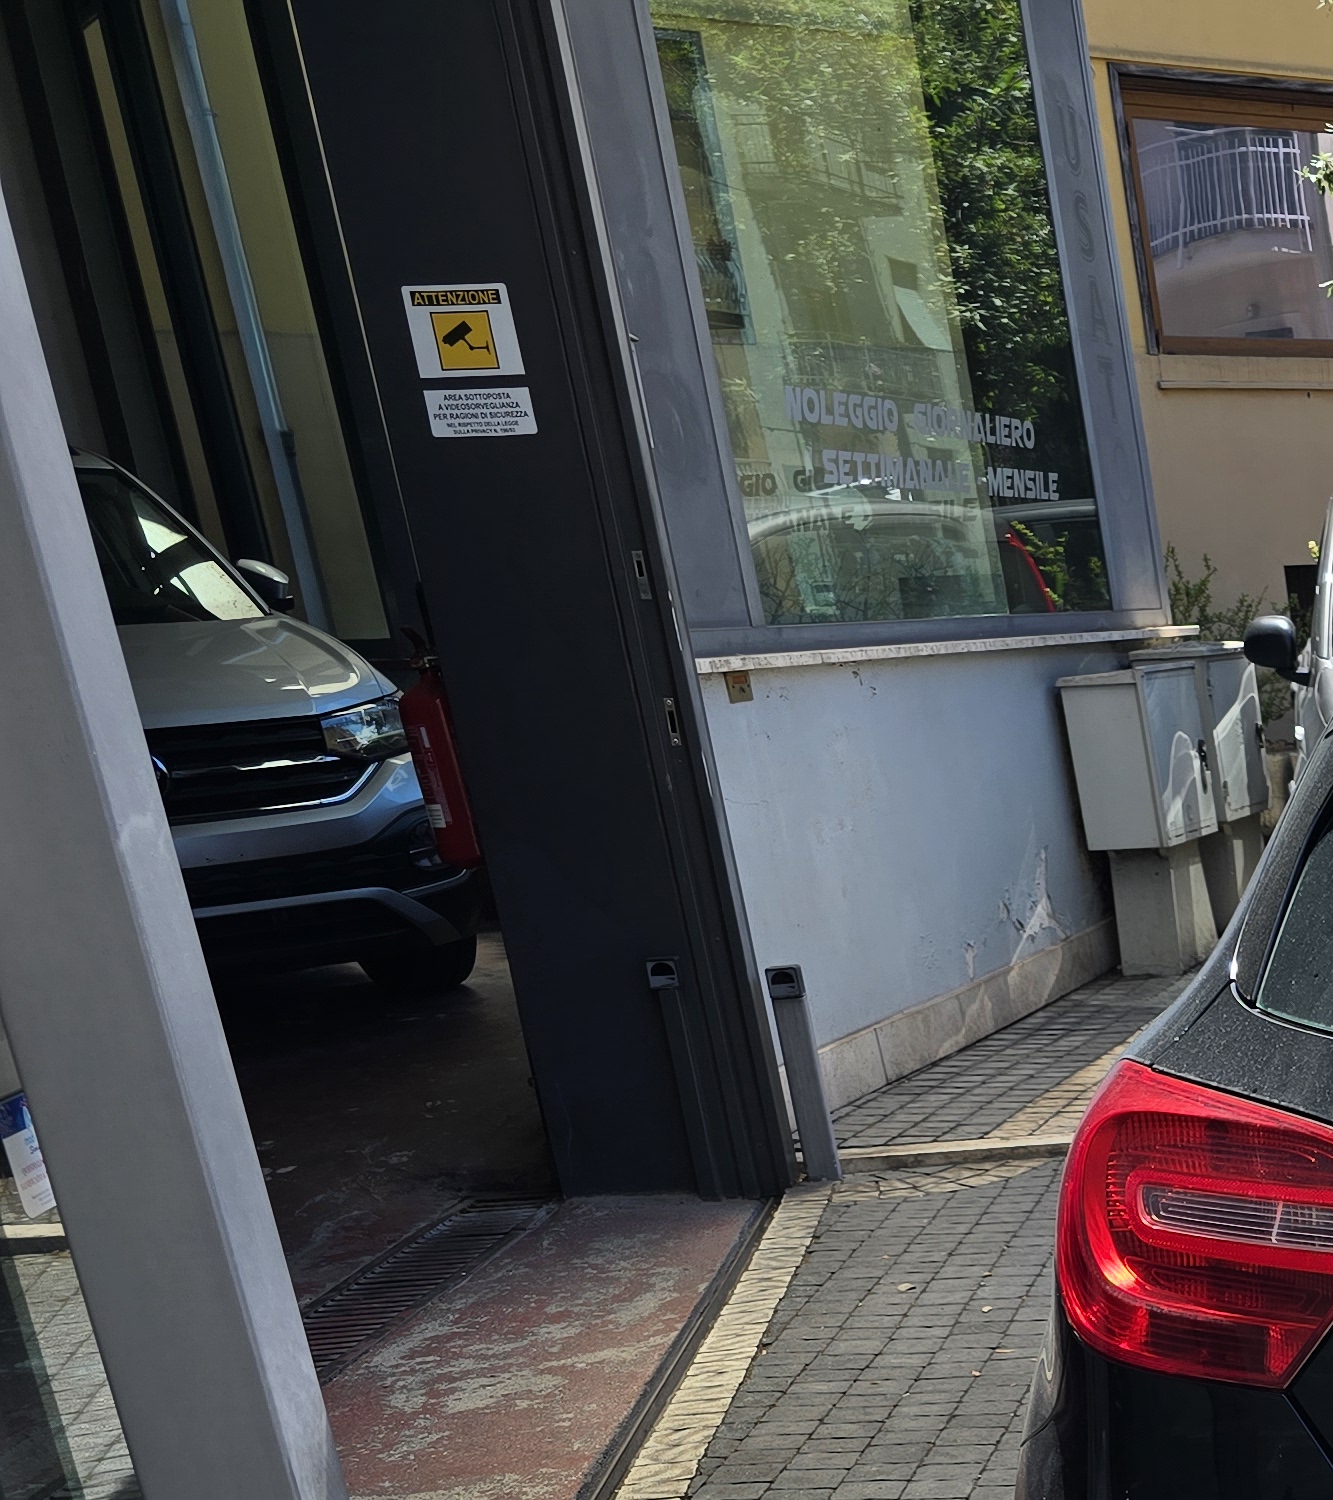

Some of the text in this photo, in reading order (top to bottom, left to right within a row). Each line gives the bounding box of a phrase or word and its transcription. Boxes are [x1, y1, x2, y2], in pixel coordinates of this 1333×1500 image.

[413, 290, 498, 306] ATTENZIONE
[443, 392, 512, 402] AREA SOTTOPOSTA
[438, 402, 521, 411] A VIDEOSORVEGLIANZA
[433, 413, 449, 421] PER
[450, 412, 480, 420] RAGIONI
[489, 411, 529, 419] SICUREZZA
[785, 385, 1035, 449] NOLEGGIO GIORNALIERO
[822, 449, 971, 493] SETTIMANALE
[987, 466, 1059, 500] MENSILE
